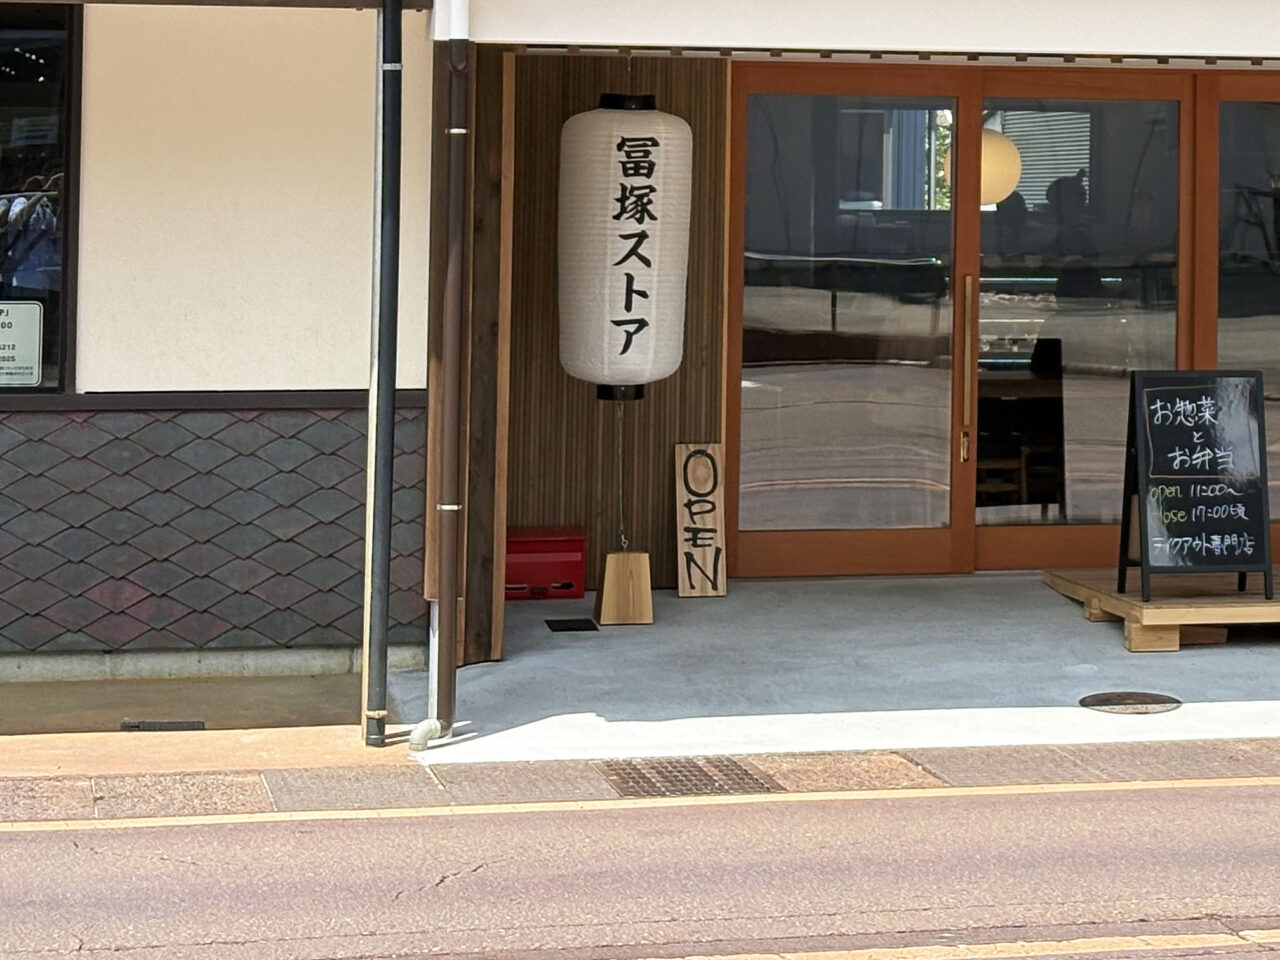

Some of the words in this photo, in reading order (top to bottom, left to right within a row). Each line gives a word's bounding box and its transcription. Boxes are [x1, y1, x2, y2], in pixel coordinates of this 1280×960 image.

[609, 135, 660, 356] 冨塚ストア
[1150, 395, 1219, 427] お惣菜
[1192, 430, 1205, 443] と
[1167, 446, 1235, 471] お弁当
[683, 449, 722, 591] OPEN
